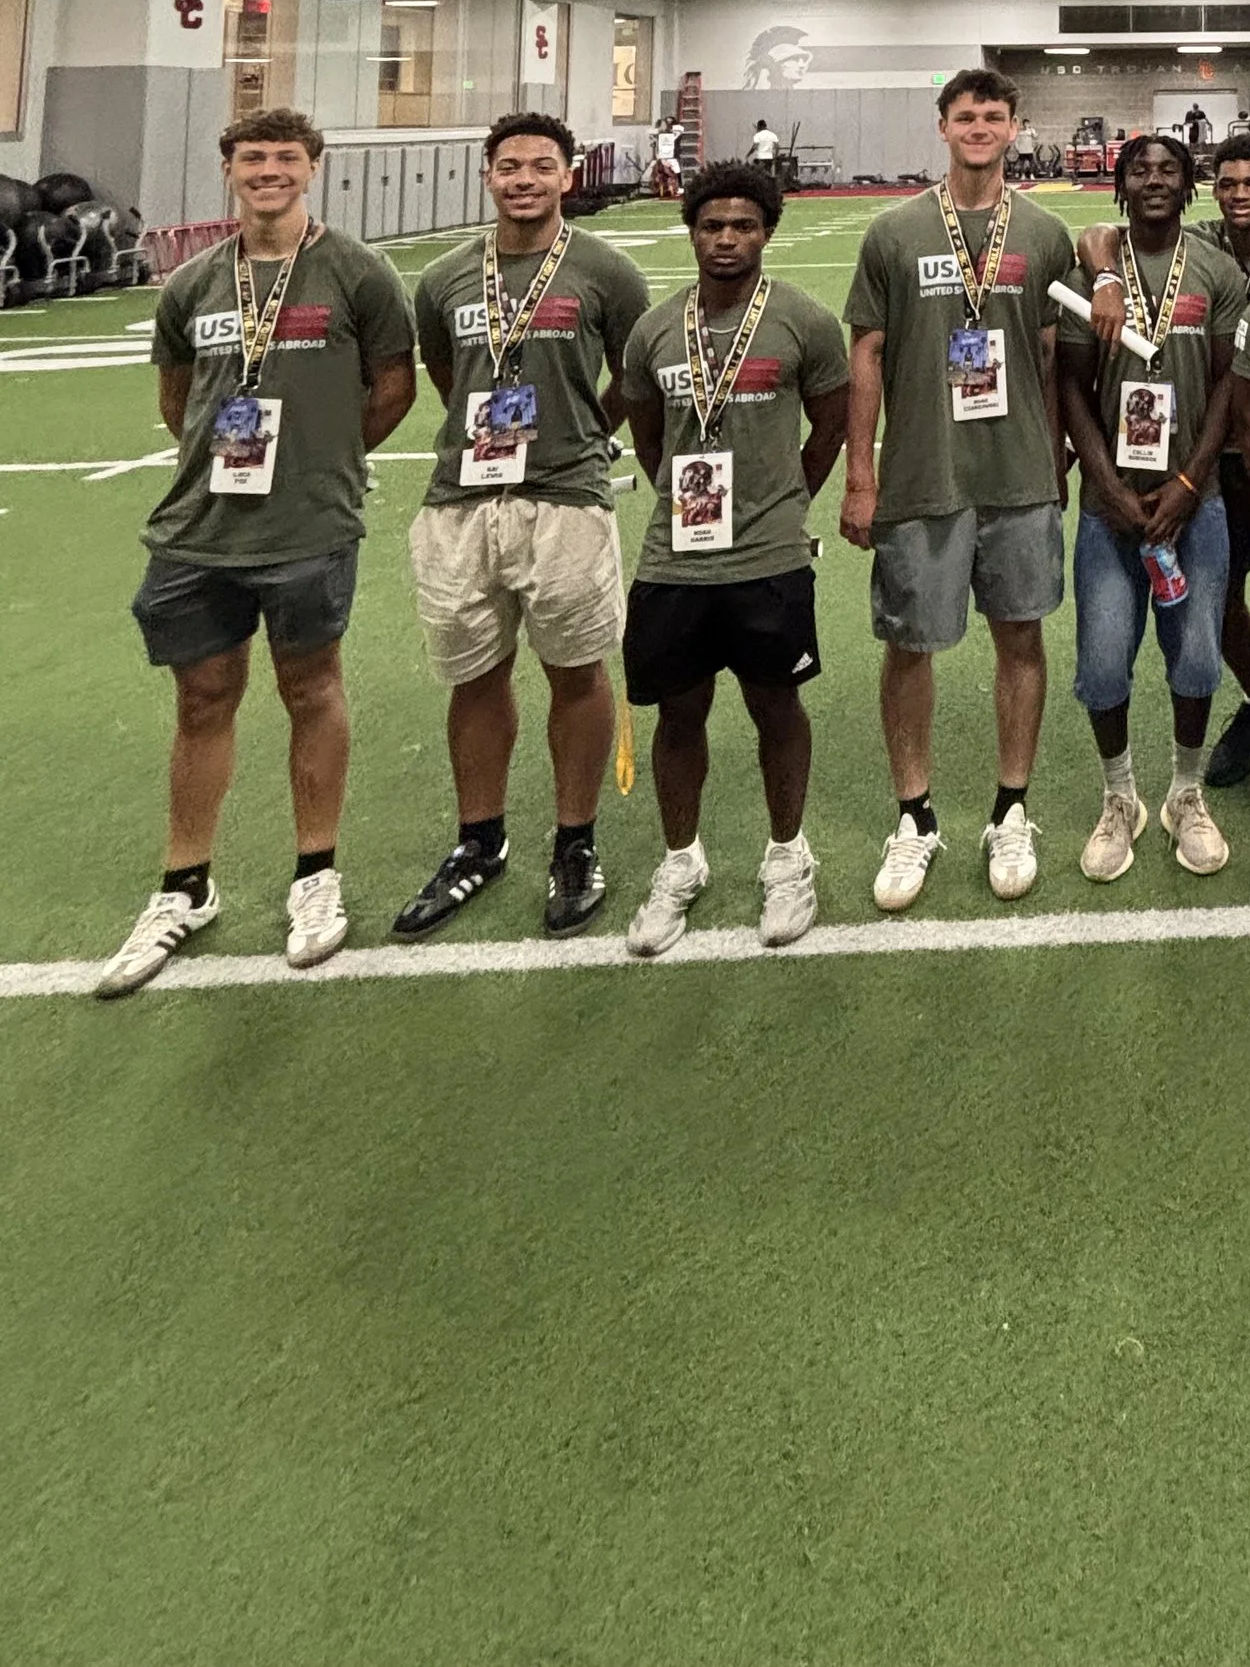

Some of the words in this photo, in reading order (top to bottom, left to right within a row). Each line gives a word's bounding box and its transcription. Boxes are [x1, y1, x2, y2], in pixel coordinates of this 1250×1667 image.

[1096, 63, 1183, 74] TROJAN
[920, 287, 952, 298] UNITED
[459, 310, 489, 331] US
[200, 317, 240, 340] US
[532, 329, 575, 340] ABROAD
[277, 339, 326, 351] ABROAD
[735, 392, 776, 403] ABROAD
